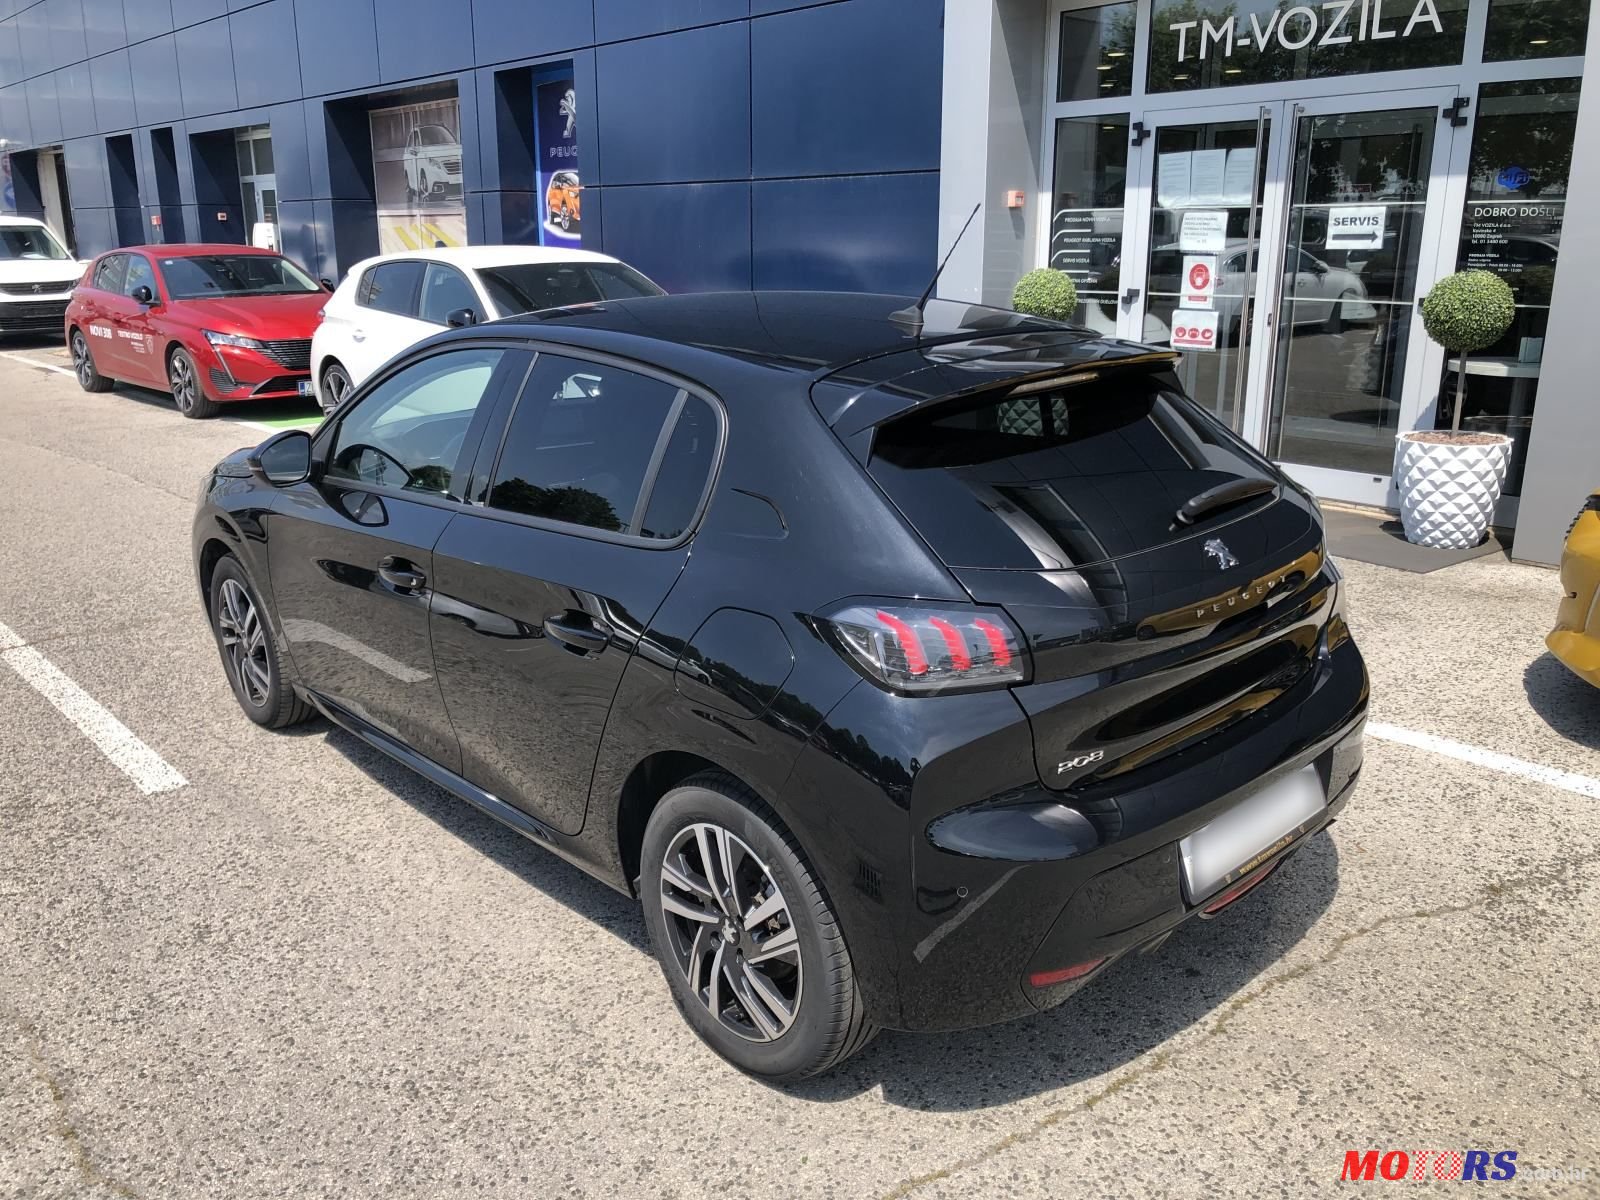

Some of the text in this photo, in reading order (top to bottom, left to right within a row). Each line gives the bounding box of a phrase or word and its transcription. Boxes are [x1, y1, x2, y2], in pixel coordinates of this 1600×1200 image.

[1170, 0, 1443, 62] TM-VOZILA
[1474, 204, 1556, 217] DOBRO DOŠLI
[1333, 216, 1379, 227] SERVIS
[90, 324, 103, 337] NOVI
[1196, 575, 1286, 618] PEUGEOT
[1057, 750, 1104, 775] 208
